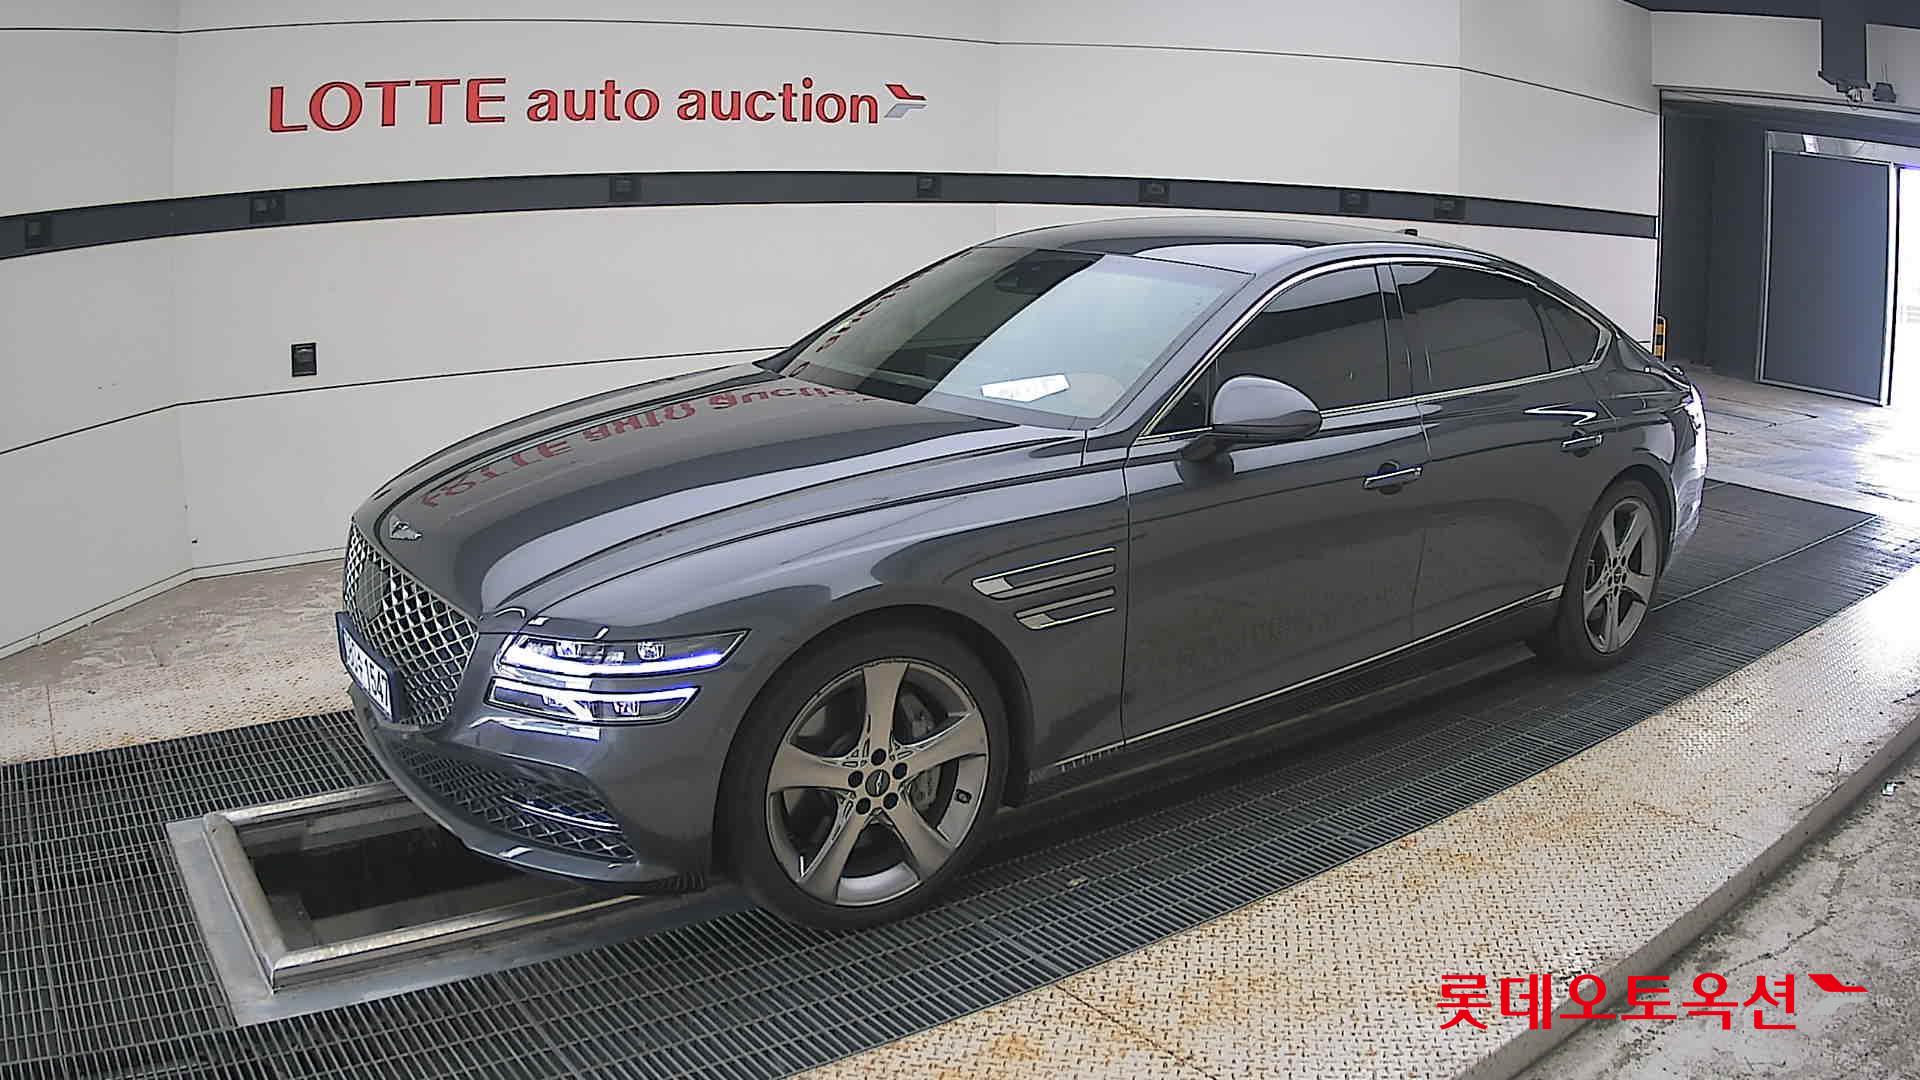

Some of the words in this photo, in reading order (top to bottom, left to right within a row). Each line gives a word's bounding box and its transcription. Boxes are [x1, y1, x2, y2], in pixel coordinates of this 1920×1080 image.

[269, 79, 505, 132] LOTTE
[527, 79, 662, 123] auto
[676, 79, 879, 125] auction
